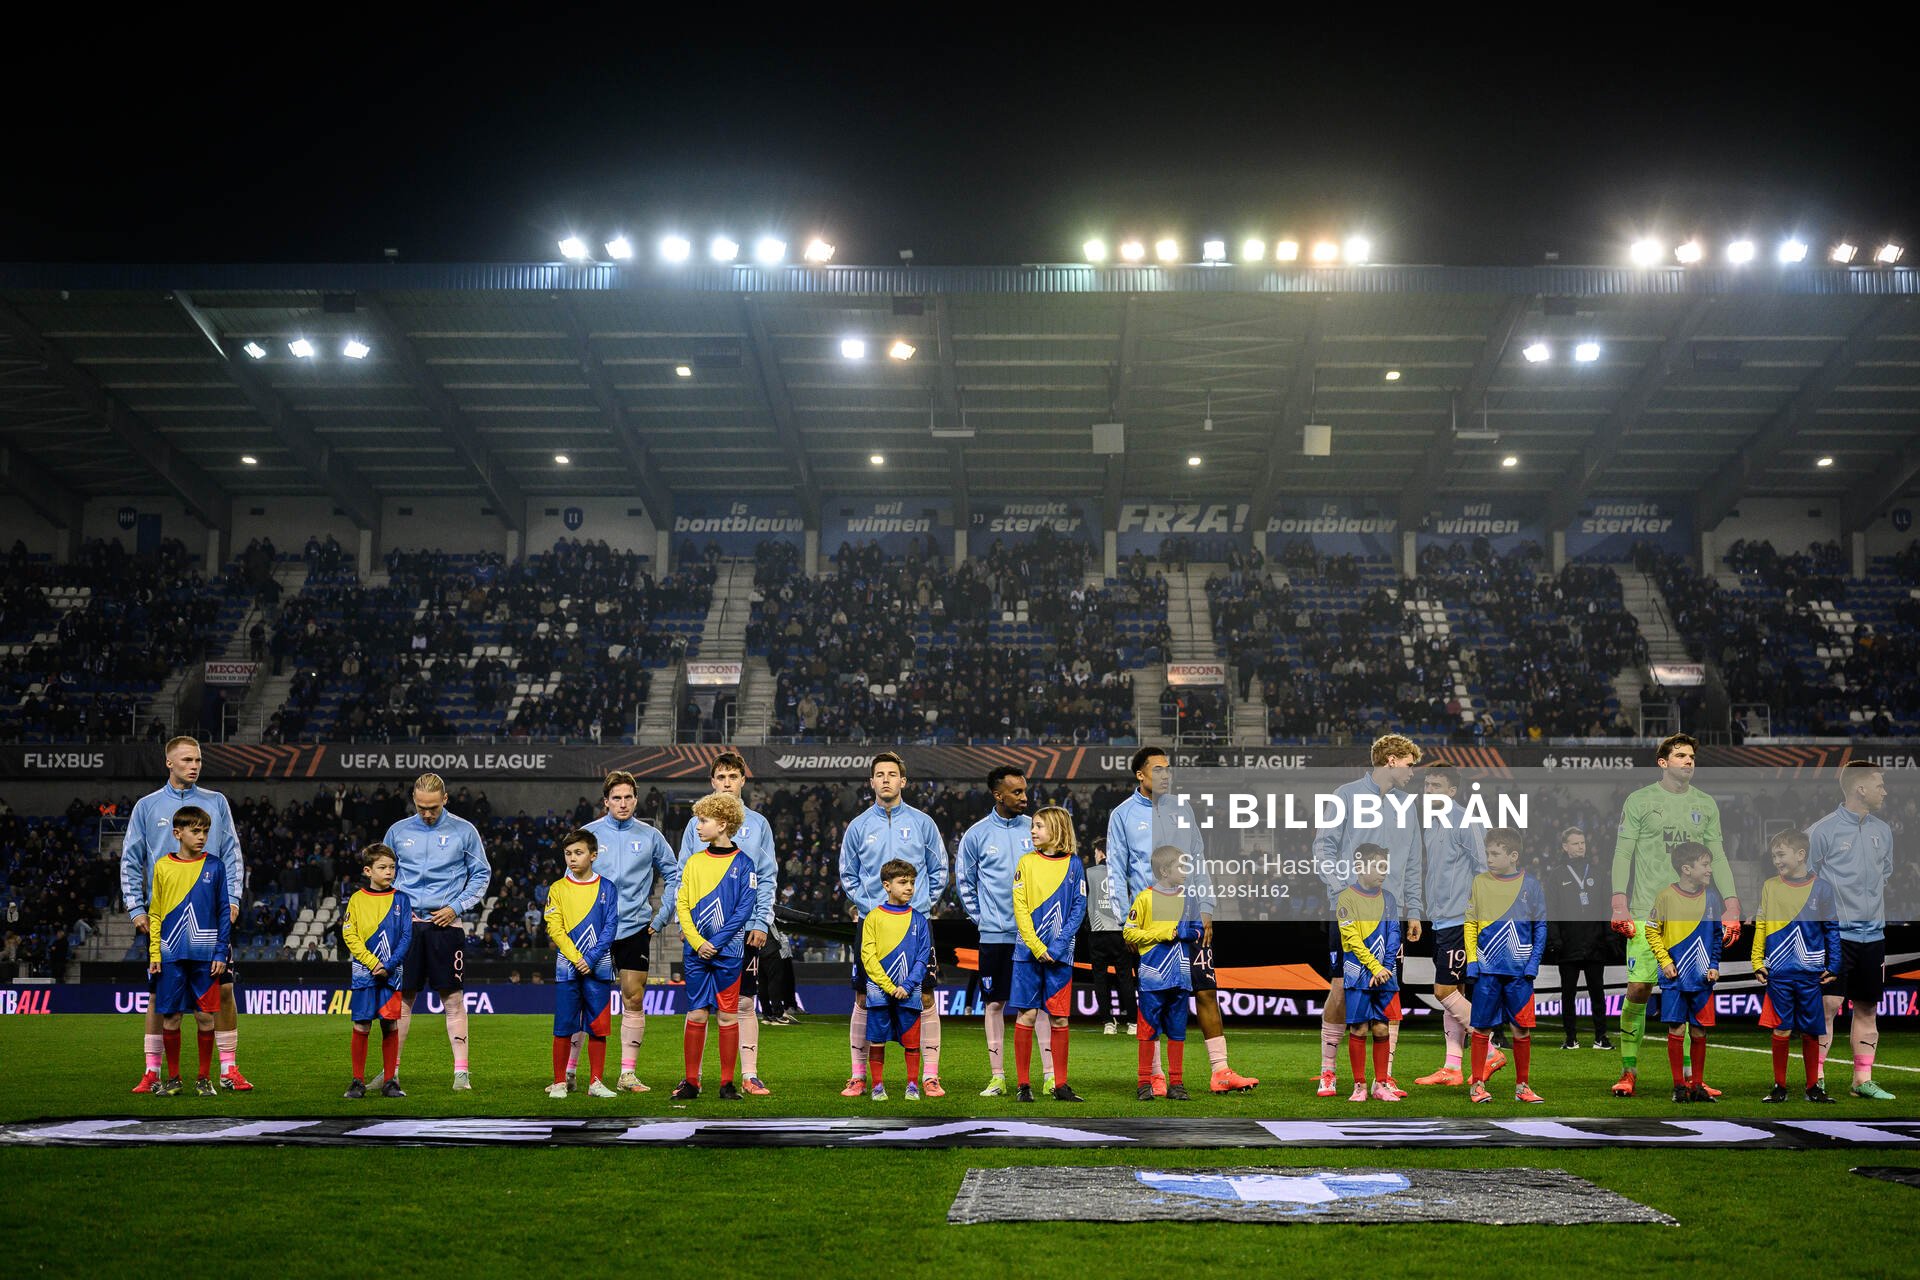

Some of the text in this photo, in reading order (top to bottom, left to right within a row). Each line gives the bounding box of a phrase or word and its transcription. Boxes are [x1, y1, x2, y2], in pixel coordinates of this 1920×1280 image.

[731, 502, 748, 516] is
[875, 502, 903, 516] wil
[1004, 502, 1067, 516] maakt
[1322, 503, 1338, 517] is
[1464, 503, 1491, 517] wil
[1595, 503, 1658, 517] maakt
[674, 517, 804, 533] bontblauw
[847, 516, 930, 533] winnen
[1117, 504, 1250, 533] FRZA!
[1266, 517, 1398, 534] bontblauw
[1437, 518, 1520, 534] winnen
[1582, 518, 1672, 534] sterker
[1169, 665, 1223, 675] MECONA
[341, 754, 546, 769] UEFA EUROPA LEAGUE
[1561, 757, 1634, 770] STRAUSS
[453, 950, 463, 971] 8
[1446, 950, 1466, 969] 19
[245, 990, 352, 1015] WELCOME AL
[427, 992, 494, 1013] UFA
[1715, 994, 1762, 1014] EFA
